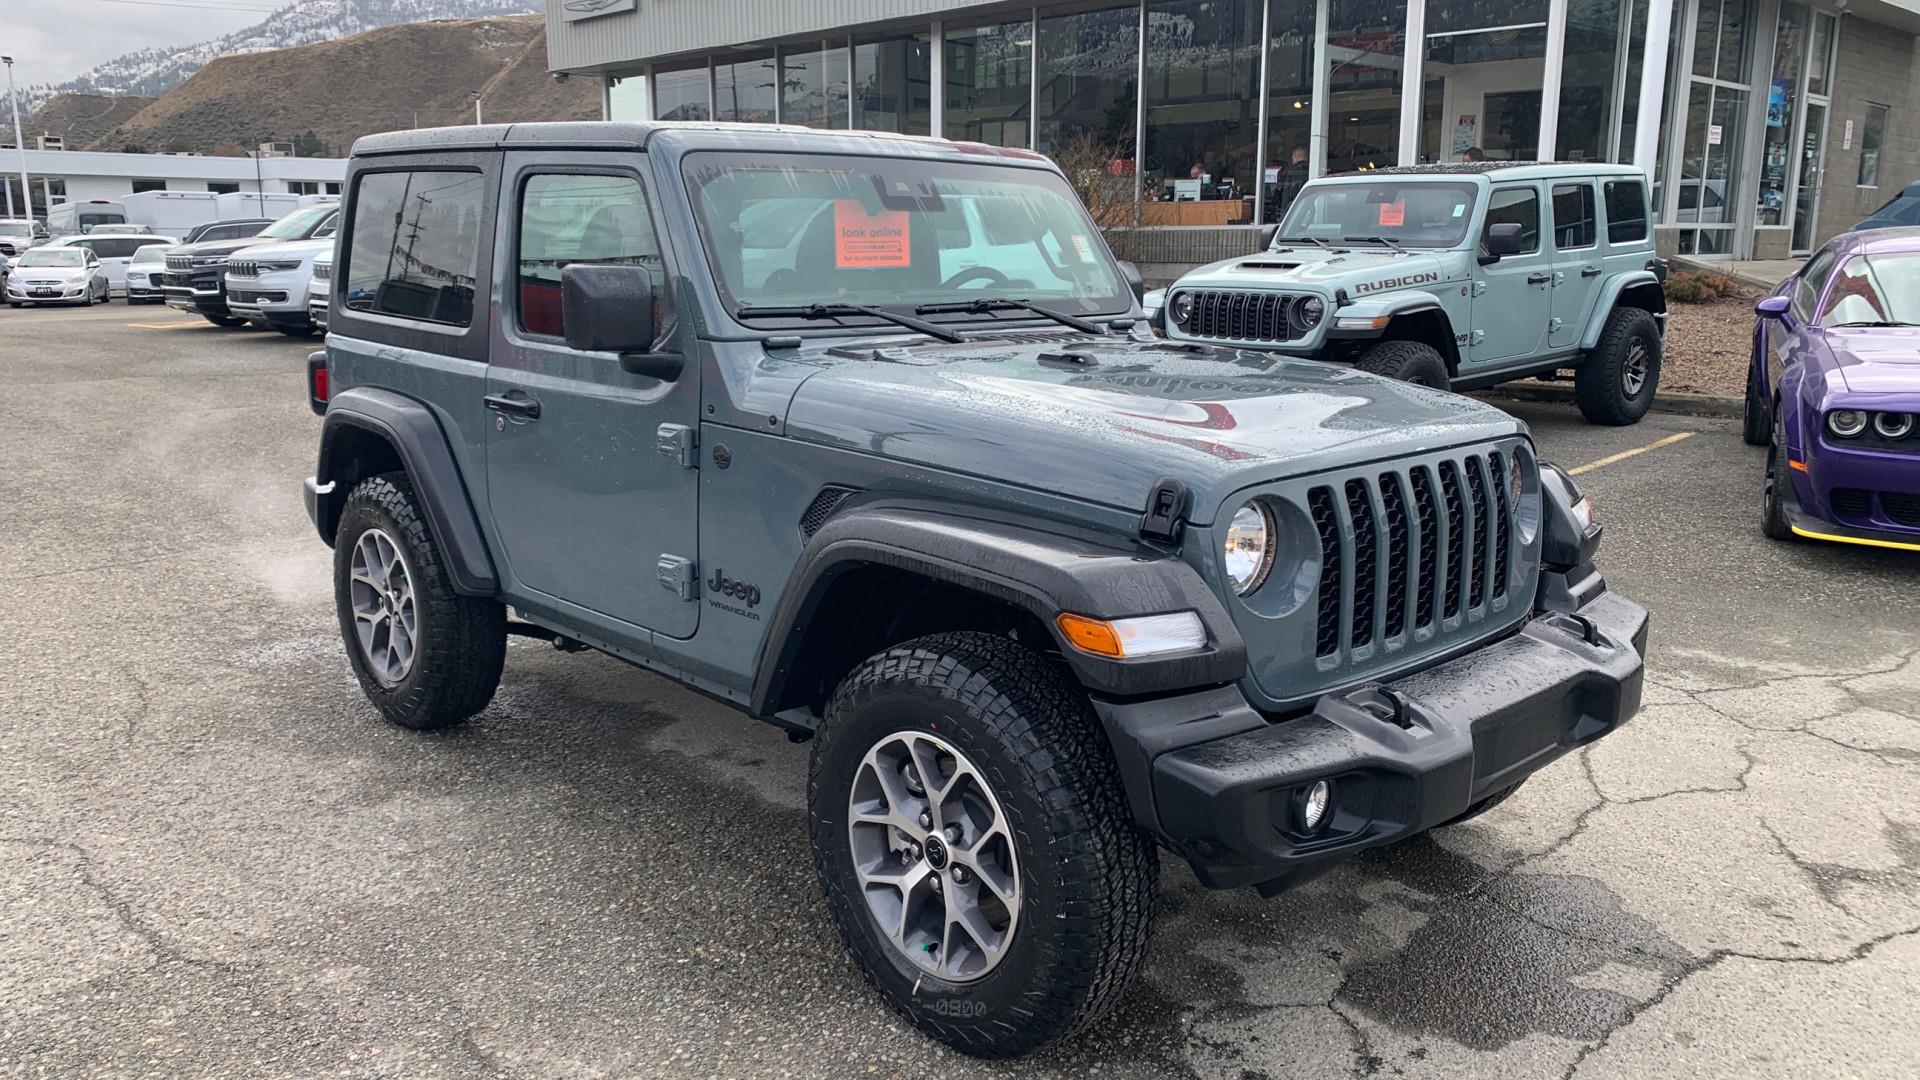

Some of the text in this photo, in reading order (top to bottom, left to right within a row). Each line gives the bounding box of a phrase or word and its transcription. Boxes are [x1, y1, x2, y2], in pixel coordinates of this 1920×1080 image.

[842, 227, 903, 237] look online
[1355, 272, 1438, 294] RUBICON
[1454, 333, 1468, 342] eep
[707, 568, 761, 608] Jeep
[709, 600, 759, 621] WRANGLER
